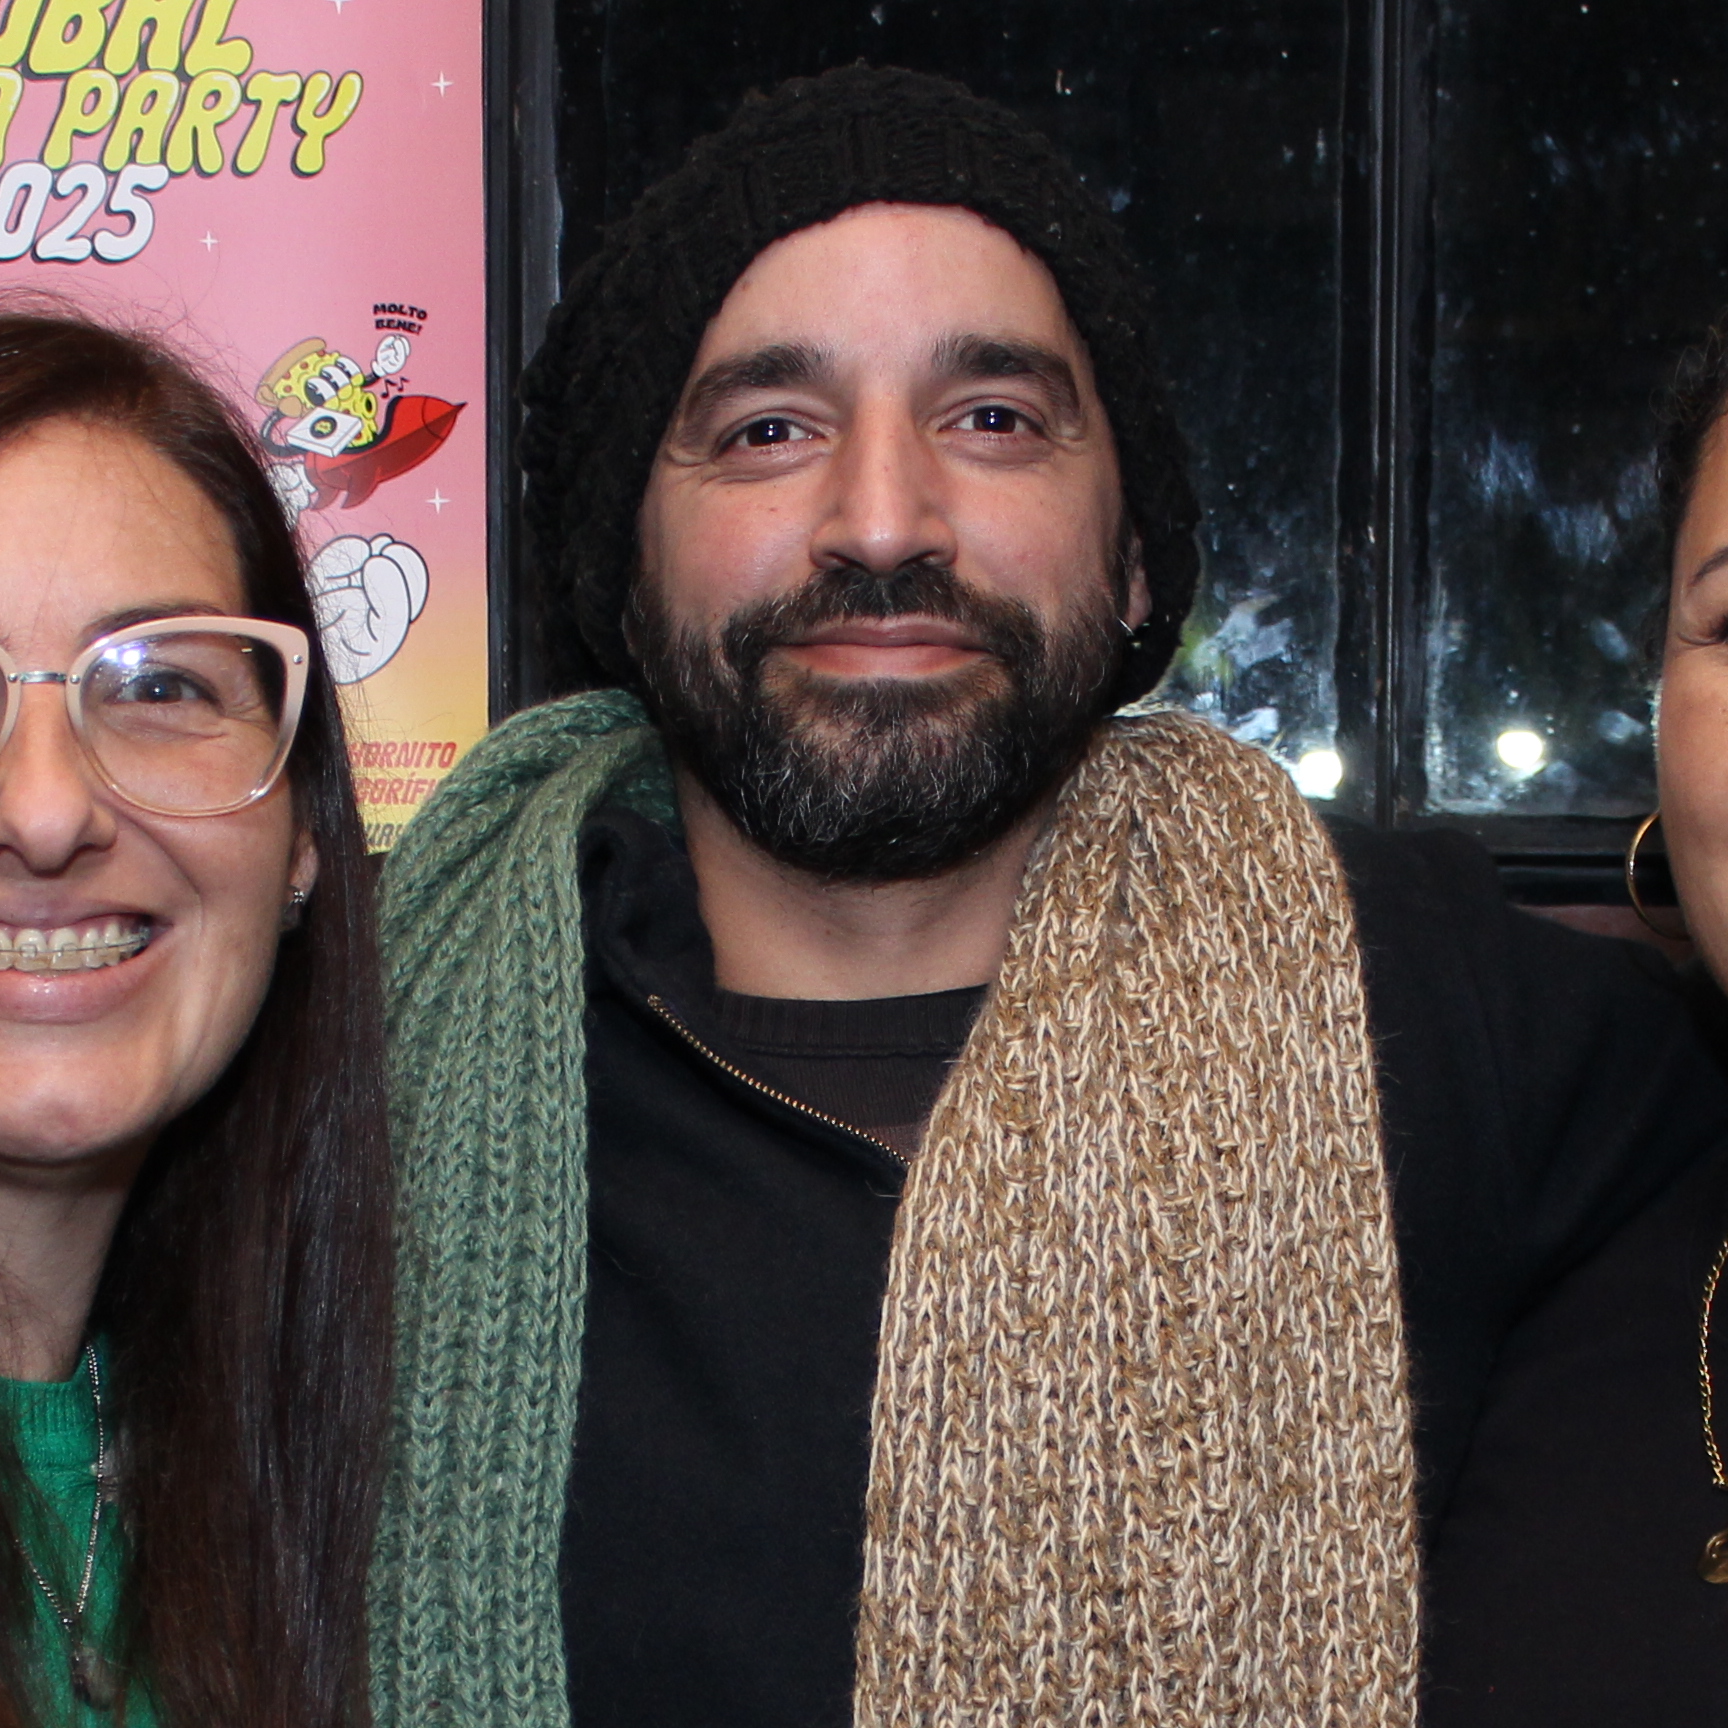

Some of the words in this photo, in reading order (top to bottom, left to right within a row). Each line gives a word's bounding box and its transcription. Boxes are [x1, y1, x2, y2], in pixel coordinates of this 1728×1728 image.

[41, 68, 364, 177] PARTY
[373, 303, 427, 320] MOLTO
[375, 319, 422, 335] BENE!
